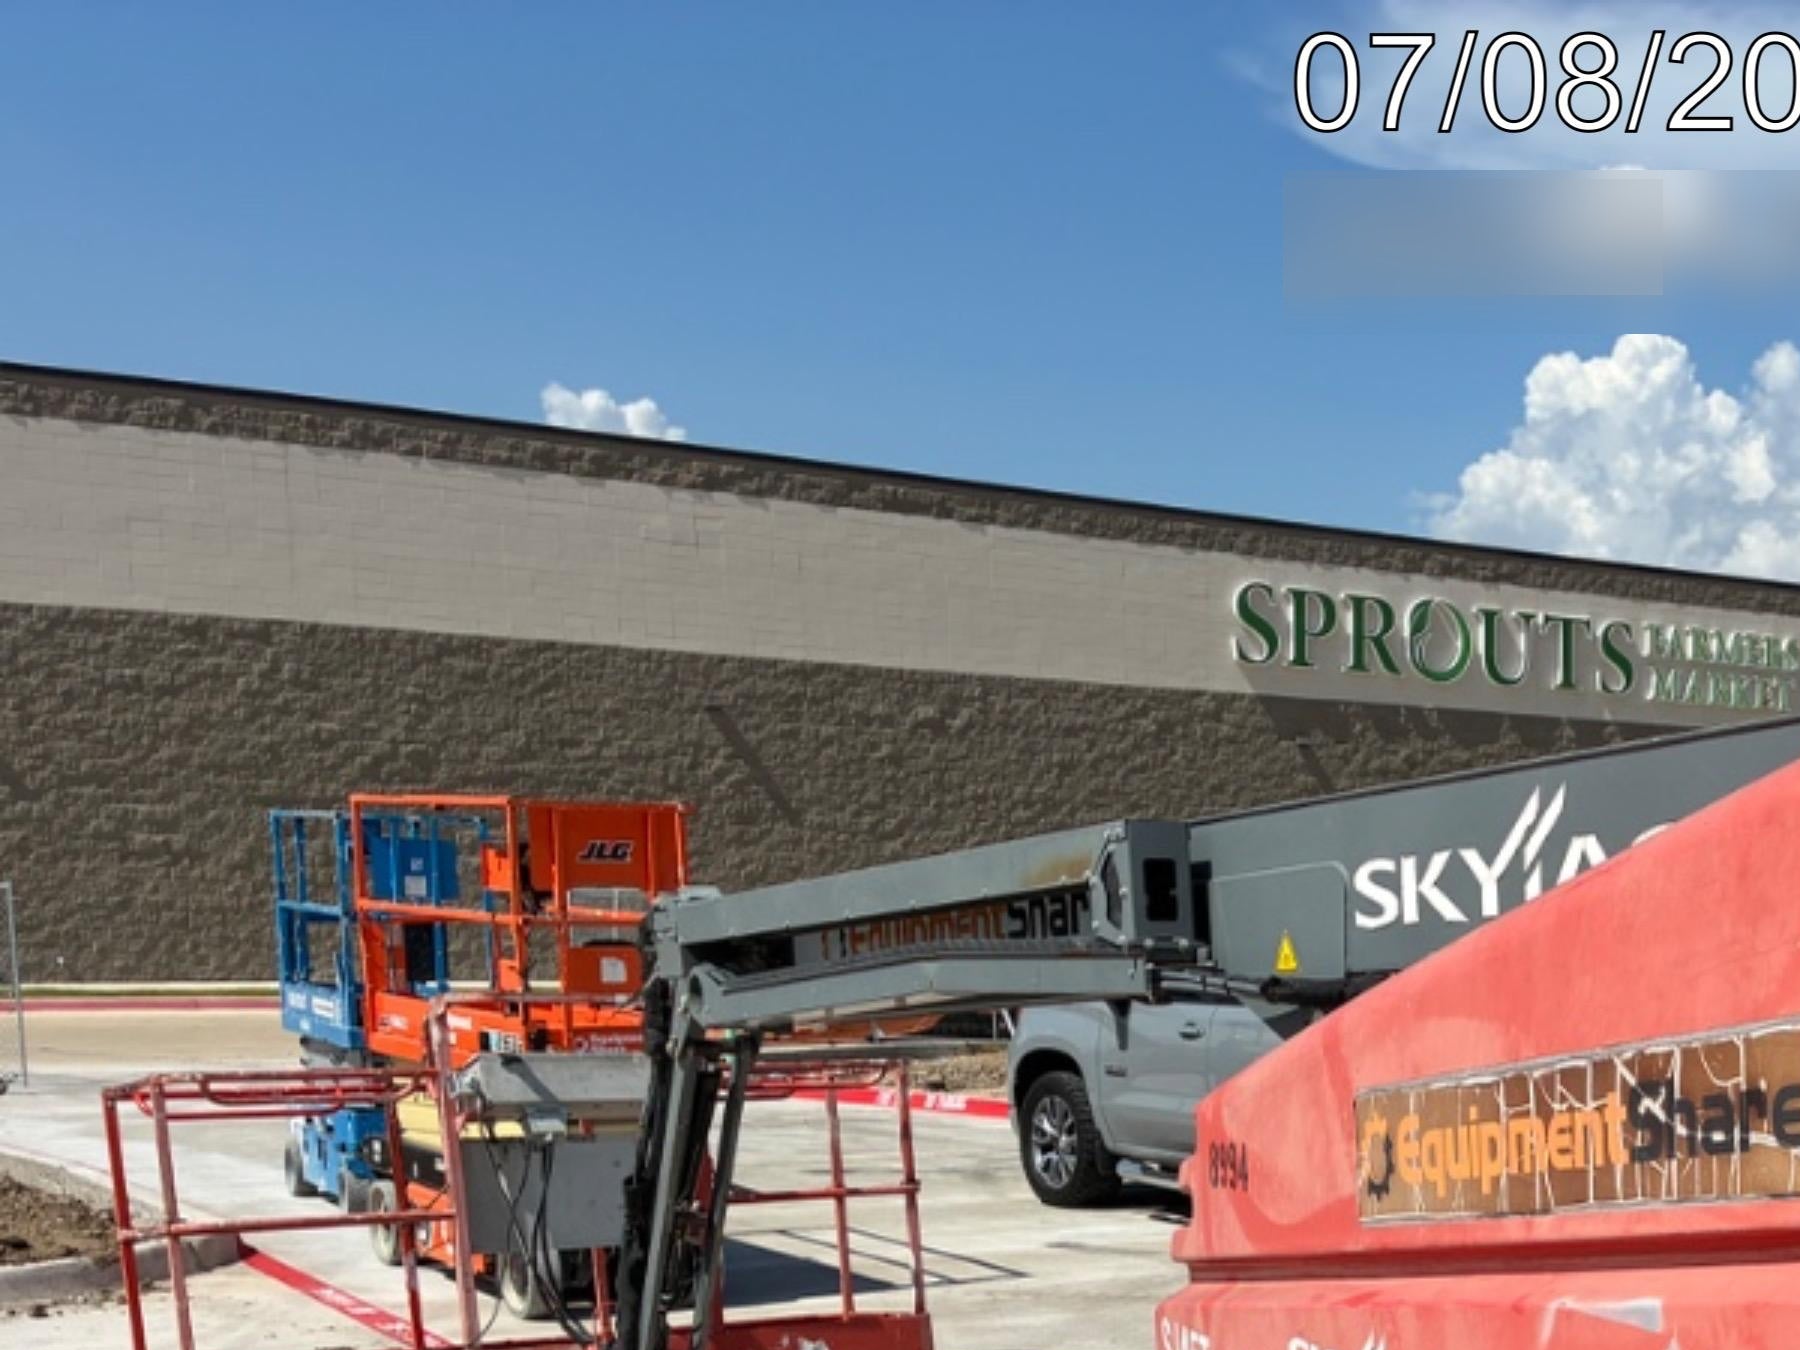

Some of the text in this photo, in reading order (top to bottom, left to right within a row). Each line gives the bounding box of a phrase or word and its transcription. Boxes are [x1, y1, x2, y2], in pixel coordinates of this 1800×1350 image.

[1232, 582, 1635, 695] SPROUTS
[1640, 621, 1800, 670] FARMERS
[1646, 666, 1792, 713] MARKET
[576, 839, 635, 865] JLG
[1208, 1140, 1249, 1193] 8994
